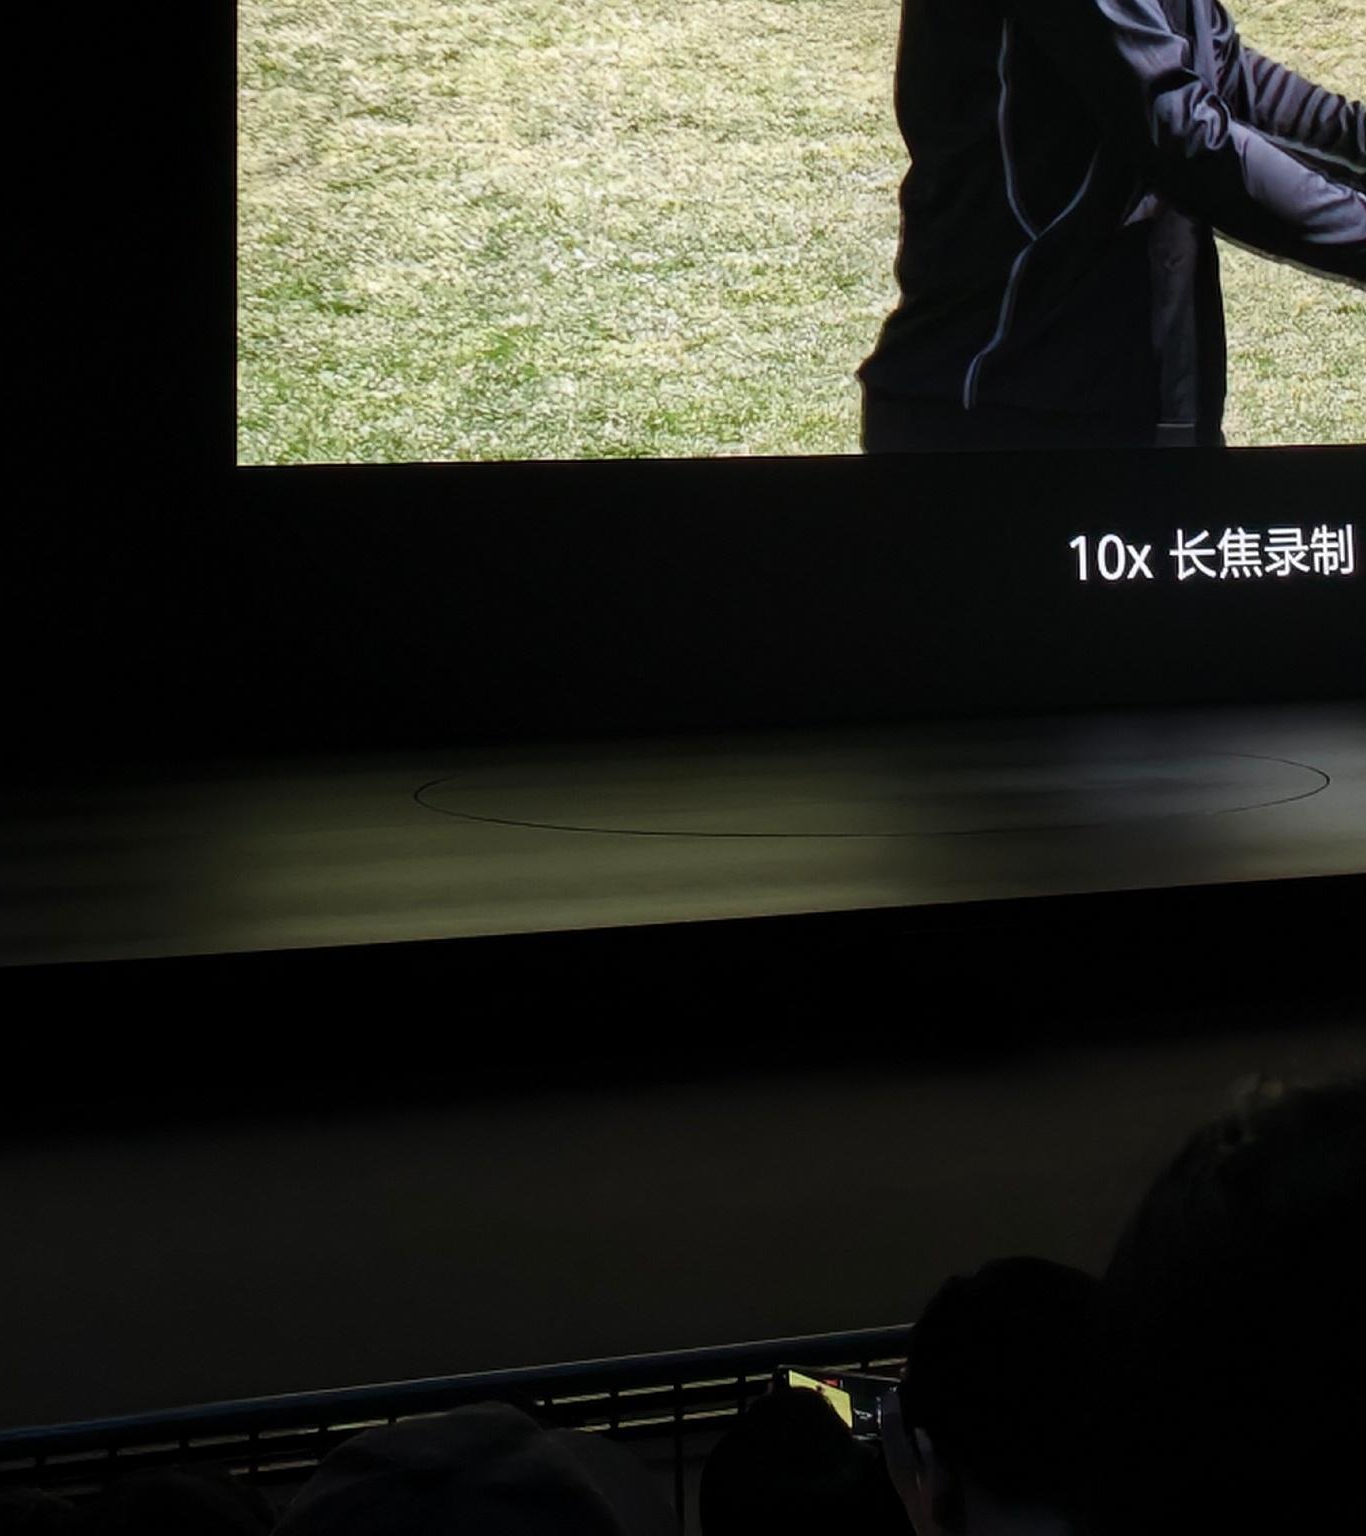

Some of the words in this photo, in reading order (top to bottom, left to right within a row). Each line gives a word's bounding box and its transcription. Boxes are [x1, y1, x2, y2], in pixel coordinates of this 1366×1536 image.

[1069, 533, 1155, 581] 10x
[1168, 523, 1355, 581] 长焦录制
